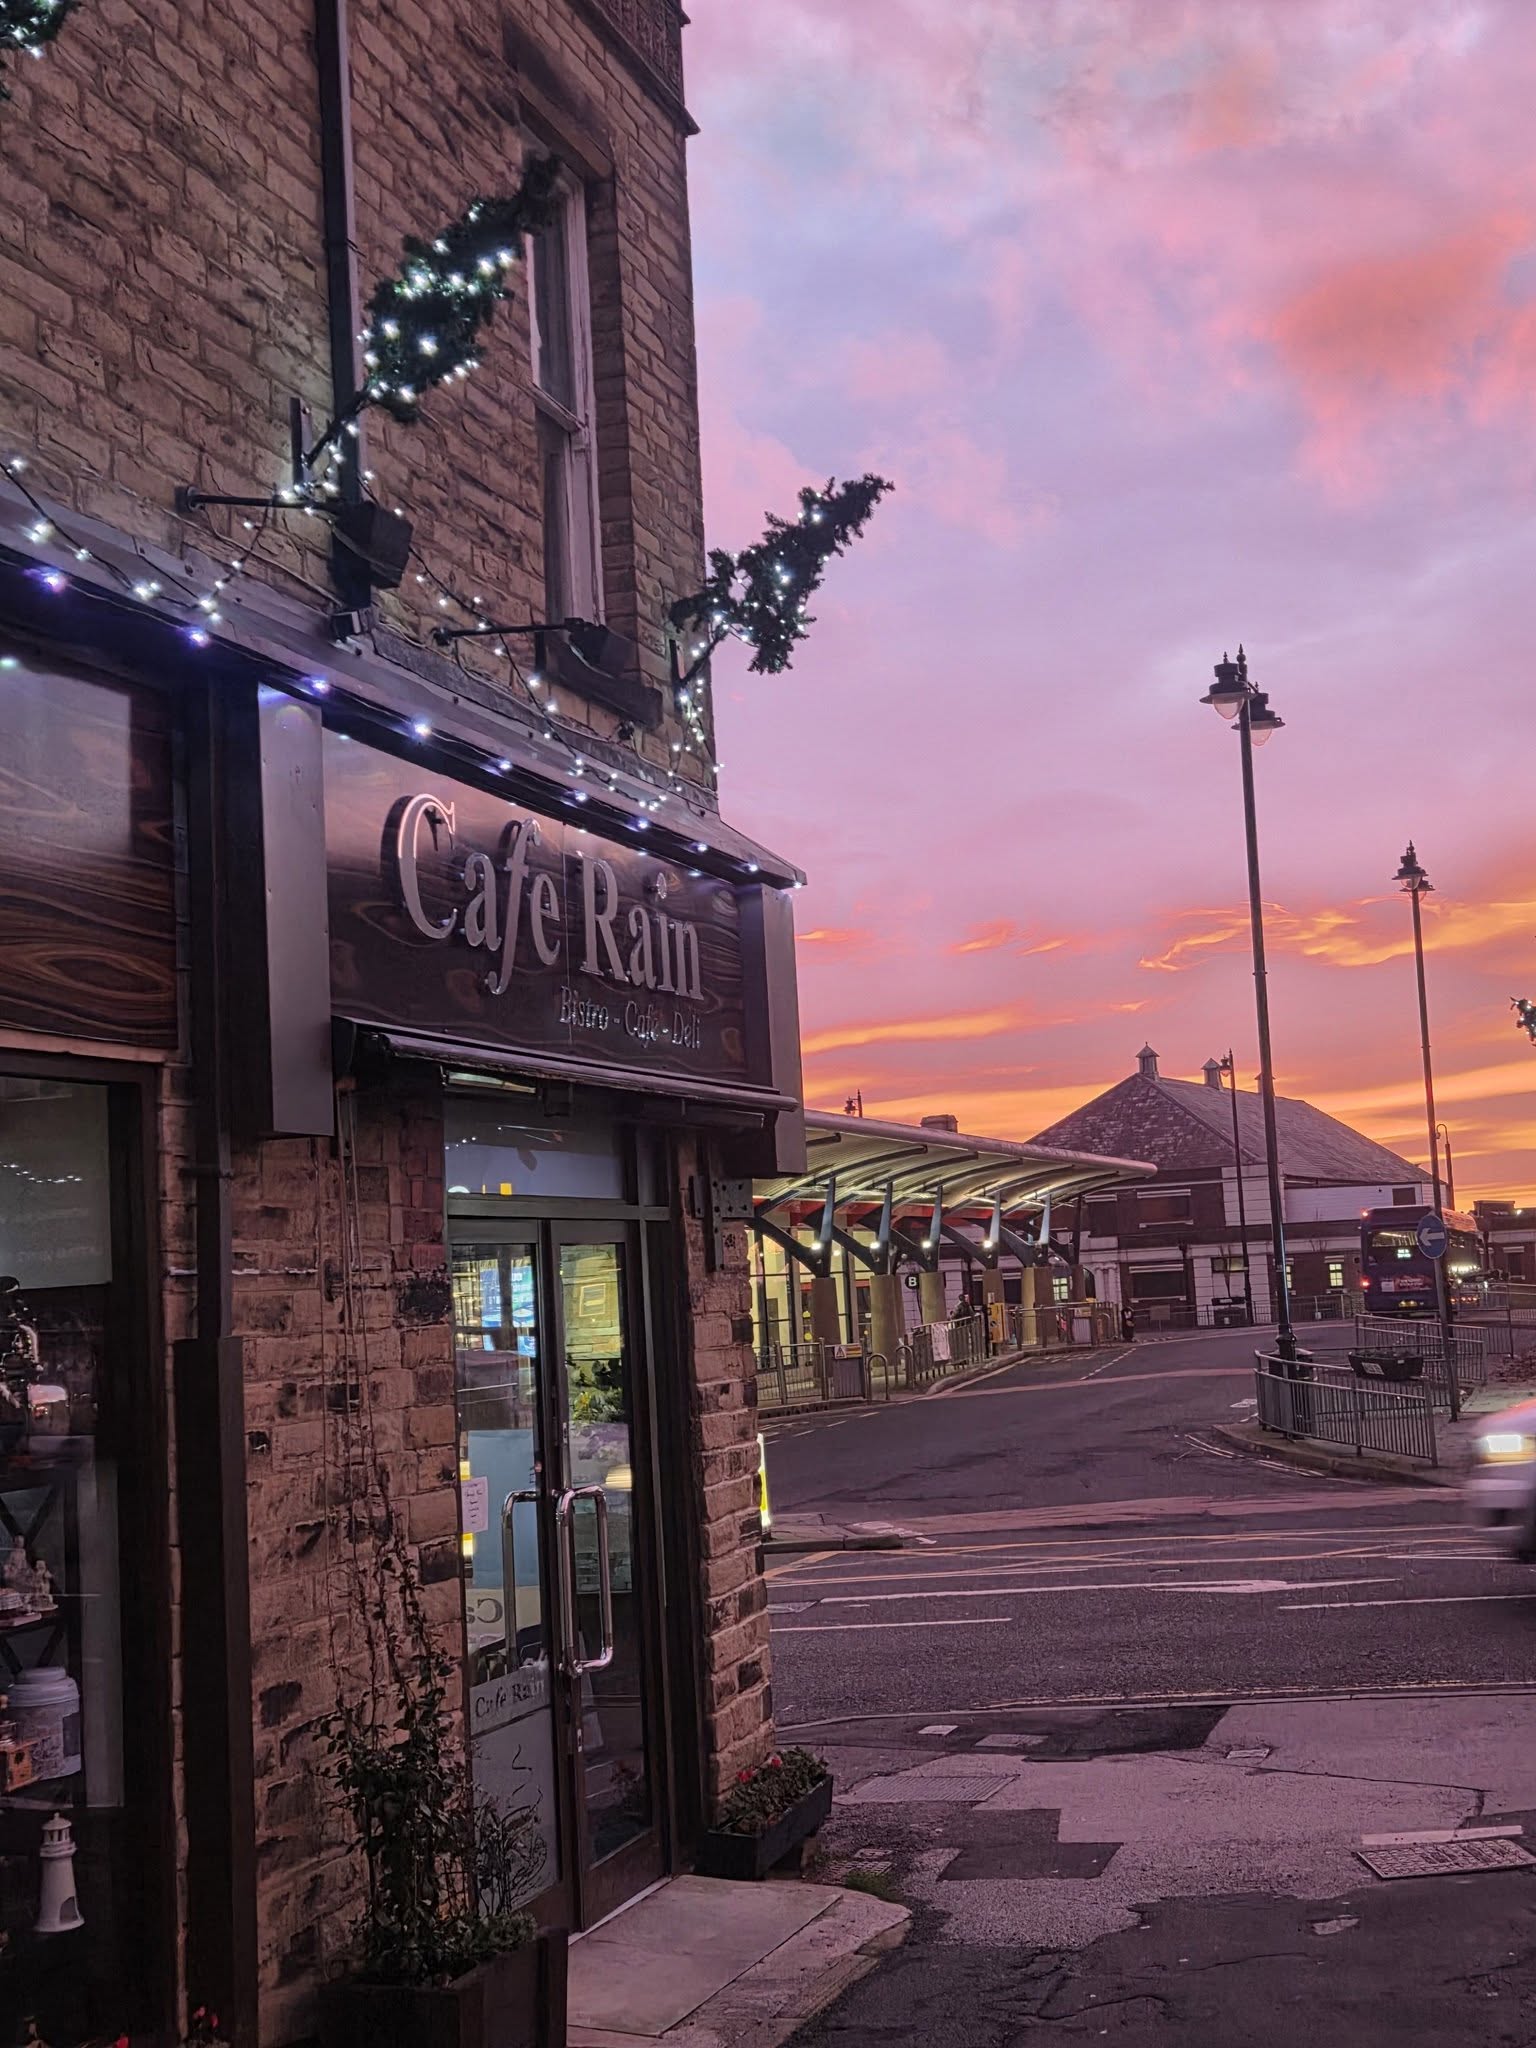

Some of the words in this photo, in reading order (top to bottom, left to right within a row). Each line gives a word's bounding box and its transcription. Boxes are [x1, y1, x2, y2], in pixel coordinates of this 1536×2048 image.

[398, 793, 561, 995] Cafe
[573, 850, 704, 1000] Rain
[560, 985, 609, 1031] Bistro
[672, 1011, 701, 1048] Deli
[908, 1276, 917, 1287] B
